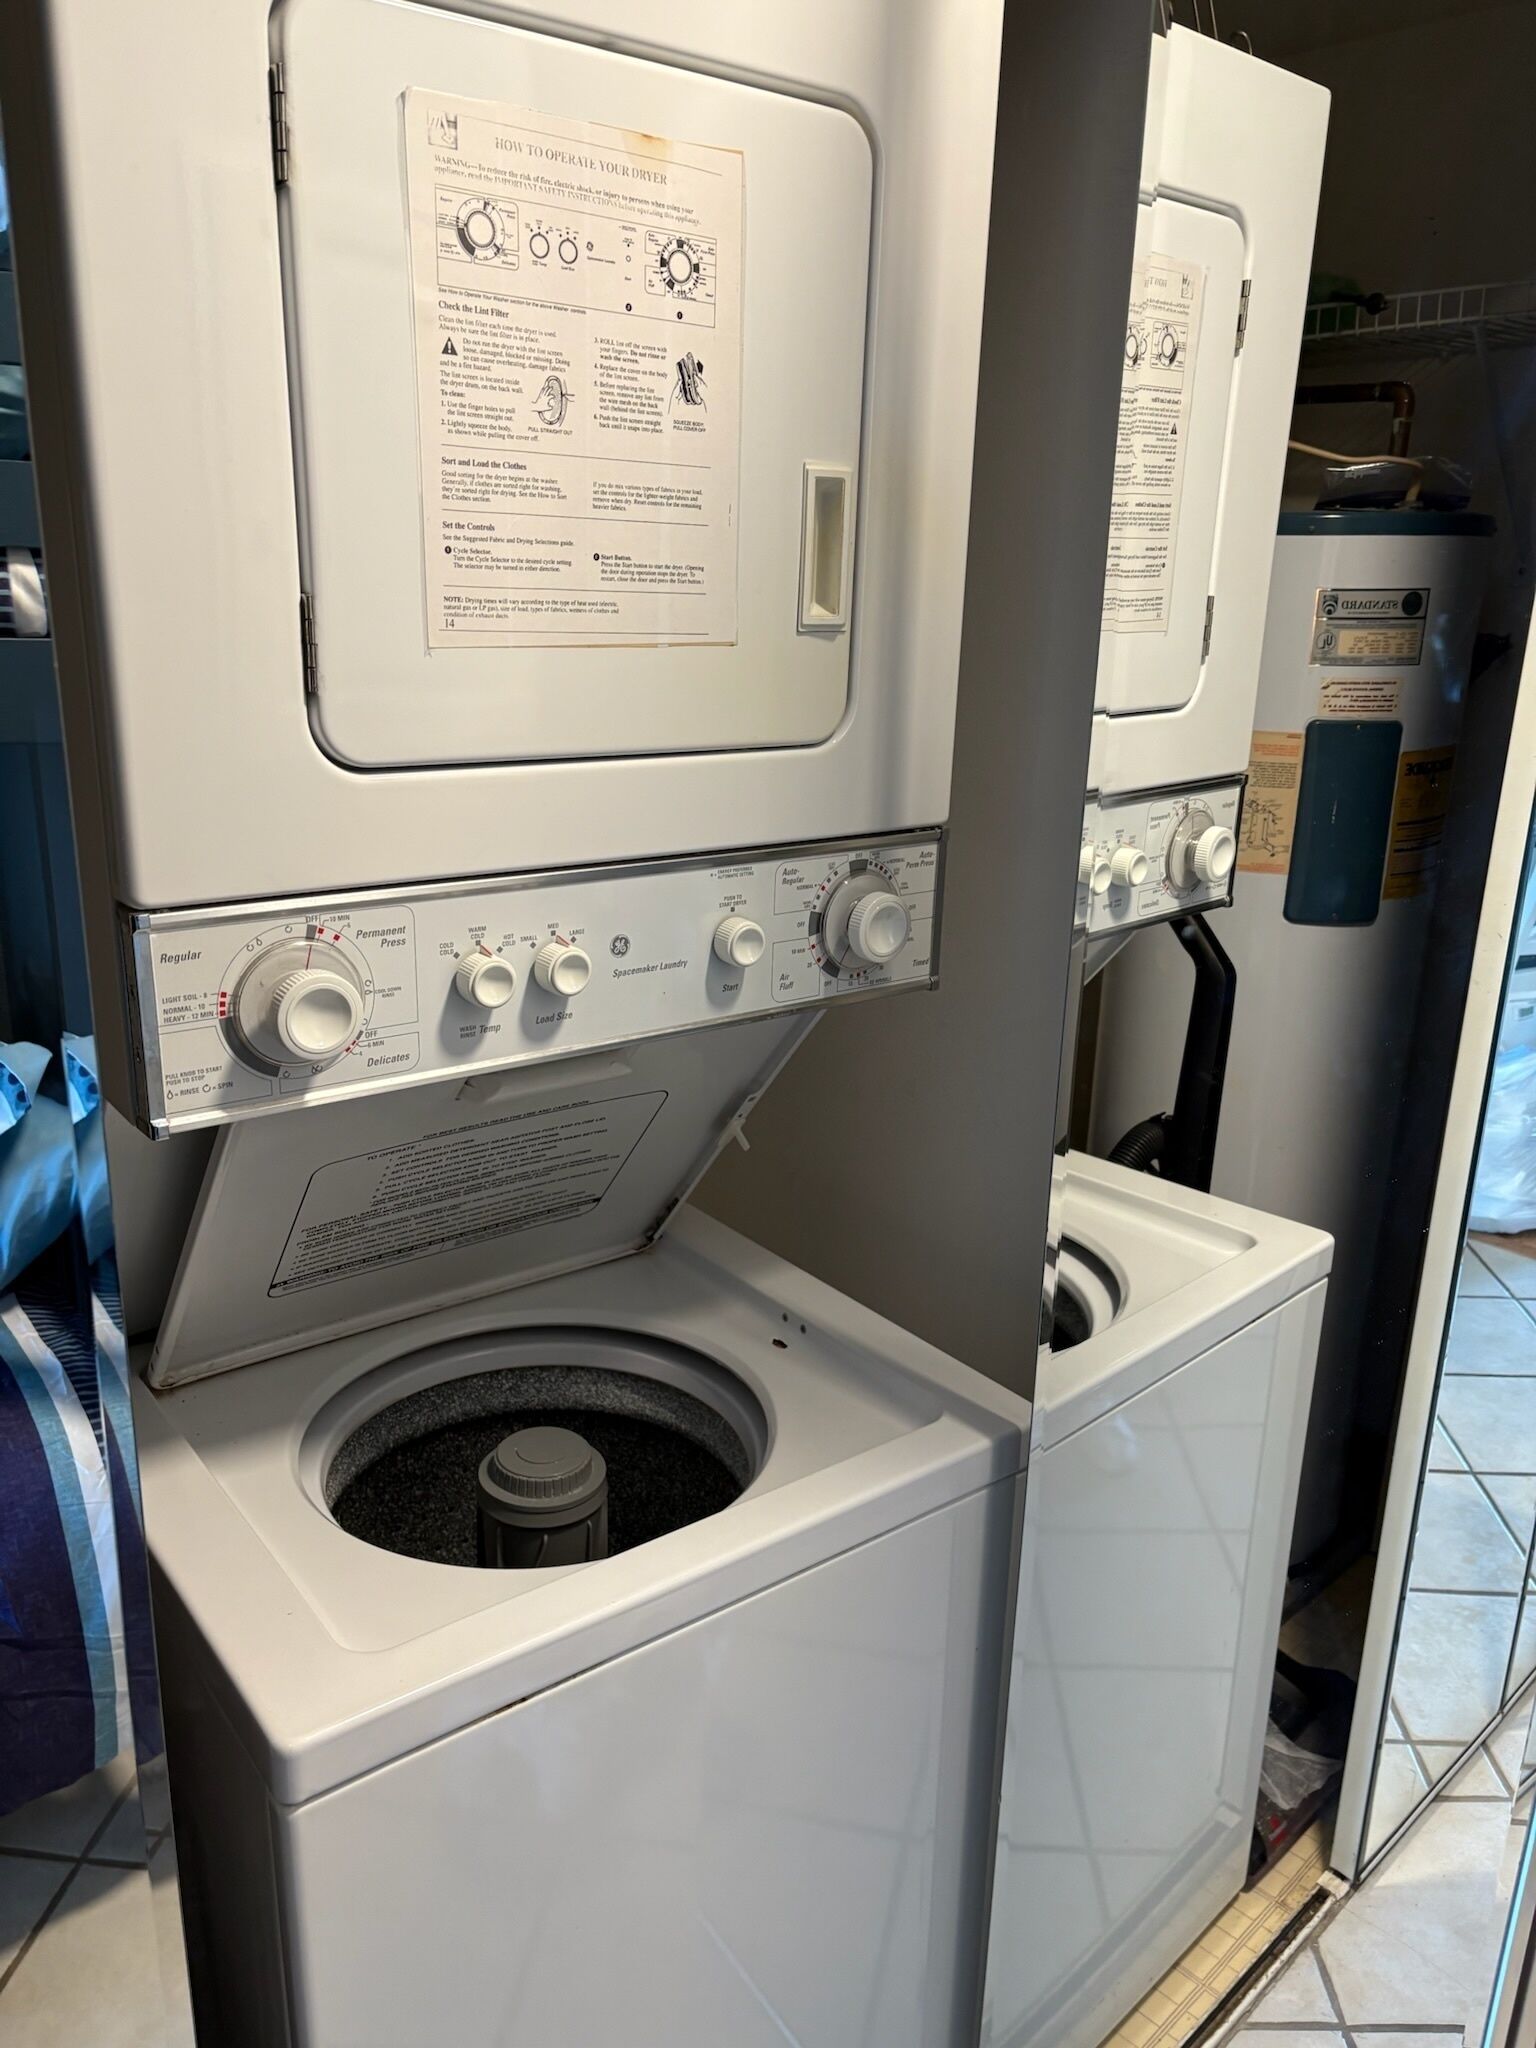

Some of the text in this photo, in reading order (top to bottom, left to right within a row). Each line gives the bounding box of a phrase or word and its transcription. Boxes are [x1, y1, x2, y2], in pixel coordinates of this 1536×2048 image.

[495, 137, 667, 185] HOW TO OPERATE YOUR DRYER
[438, 300, 509, 318] Check the Lint Filter
[441, 456, 526, 470] Sort and Load the Clothes
[442, 521, 494, 531] Set the Controls
[445, 618, 454, 628] 14
[919, 850, 935, 858] Auto-
[905, 859, 934, 869] Perm Press
[782, 866, 799, 876] Auto-
[782, 875, 804, 886] Regular
[305, 915, 319, 923] OFF
[355, 924, 406, 940] Permanent
[468, 925, 486, 933] WARM
[380, 936, 405, 948] Press
[520, 934, 537, 942] SMALL
[159, 949, 202, 964] Regular
[912, 957, 929, 967] Timed
[612, 958, 687, 979] Spacemaker Laundry
[779, 972, 789, 981] Air
[722, 981, 738, 992] Start
[779, 981, 793, 991] Fluff
[161, 995, 181, 1004] LIGHT
[184, 993, 197, 1001] SOIL
[162, 1005, 192, 1015] NORMAL
[163, 1015, 186, 1024] HEAVY
[199, 1011, 214, 1019] MIN
[536, 1010, 572, 1024] Load Size
[459, 1024, 476, 1033] WASH
[479, 1022, 500, 1035] Temp
[365, 1030, 377, 1038] OFF
[460, 1031, 476, 1039] RINSE
[372, 1039, 384, 1047] MIN
[366, 1051, 409, 1067] Delicates
[178, 1070, 192, 1078] KNOB
[202, 1065, 222, 1074] START
[189, 1074, 205, 1082] STOP
[217, 1081, 233, 1090] SPIN
[180, 1086, 199, 1097] RINSE
